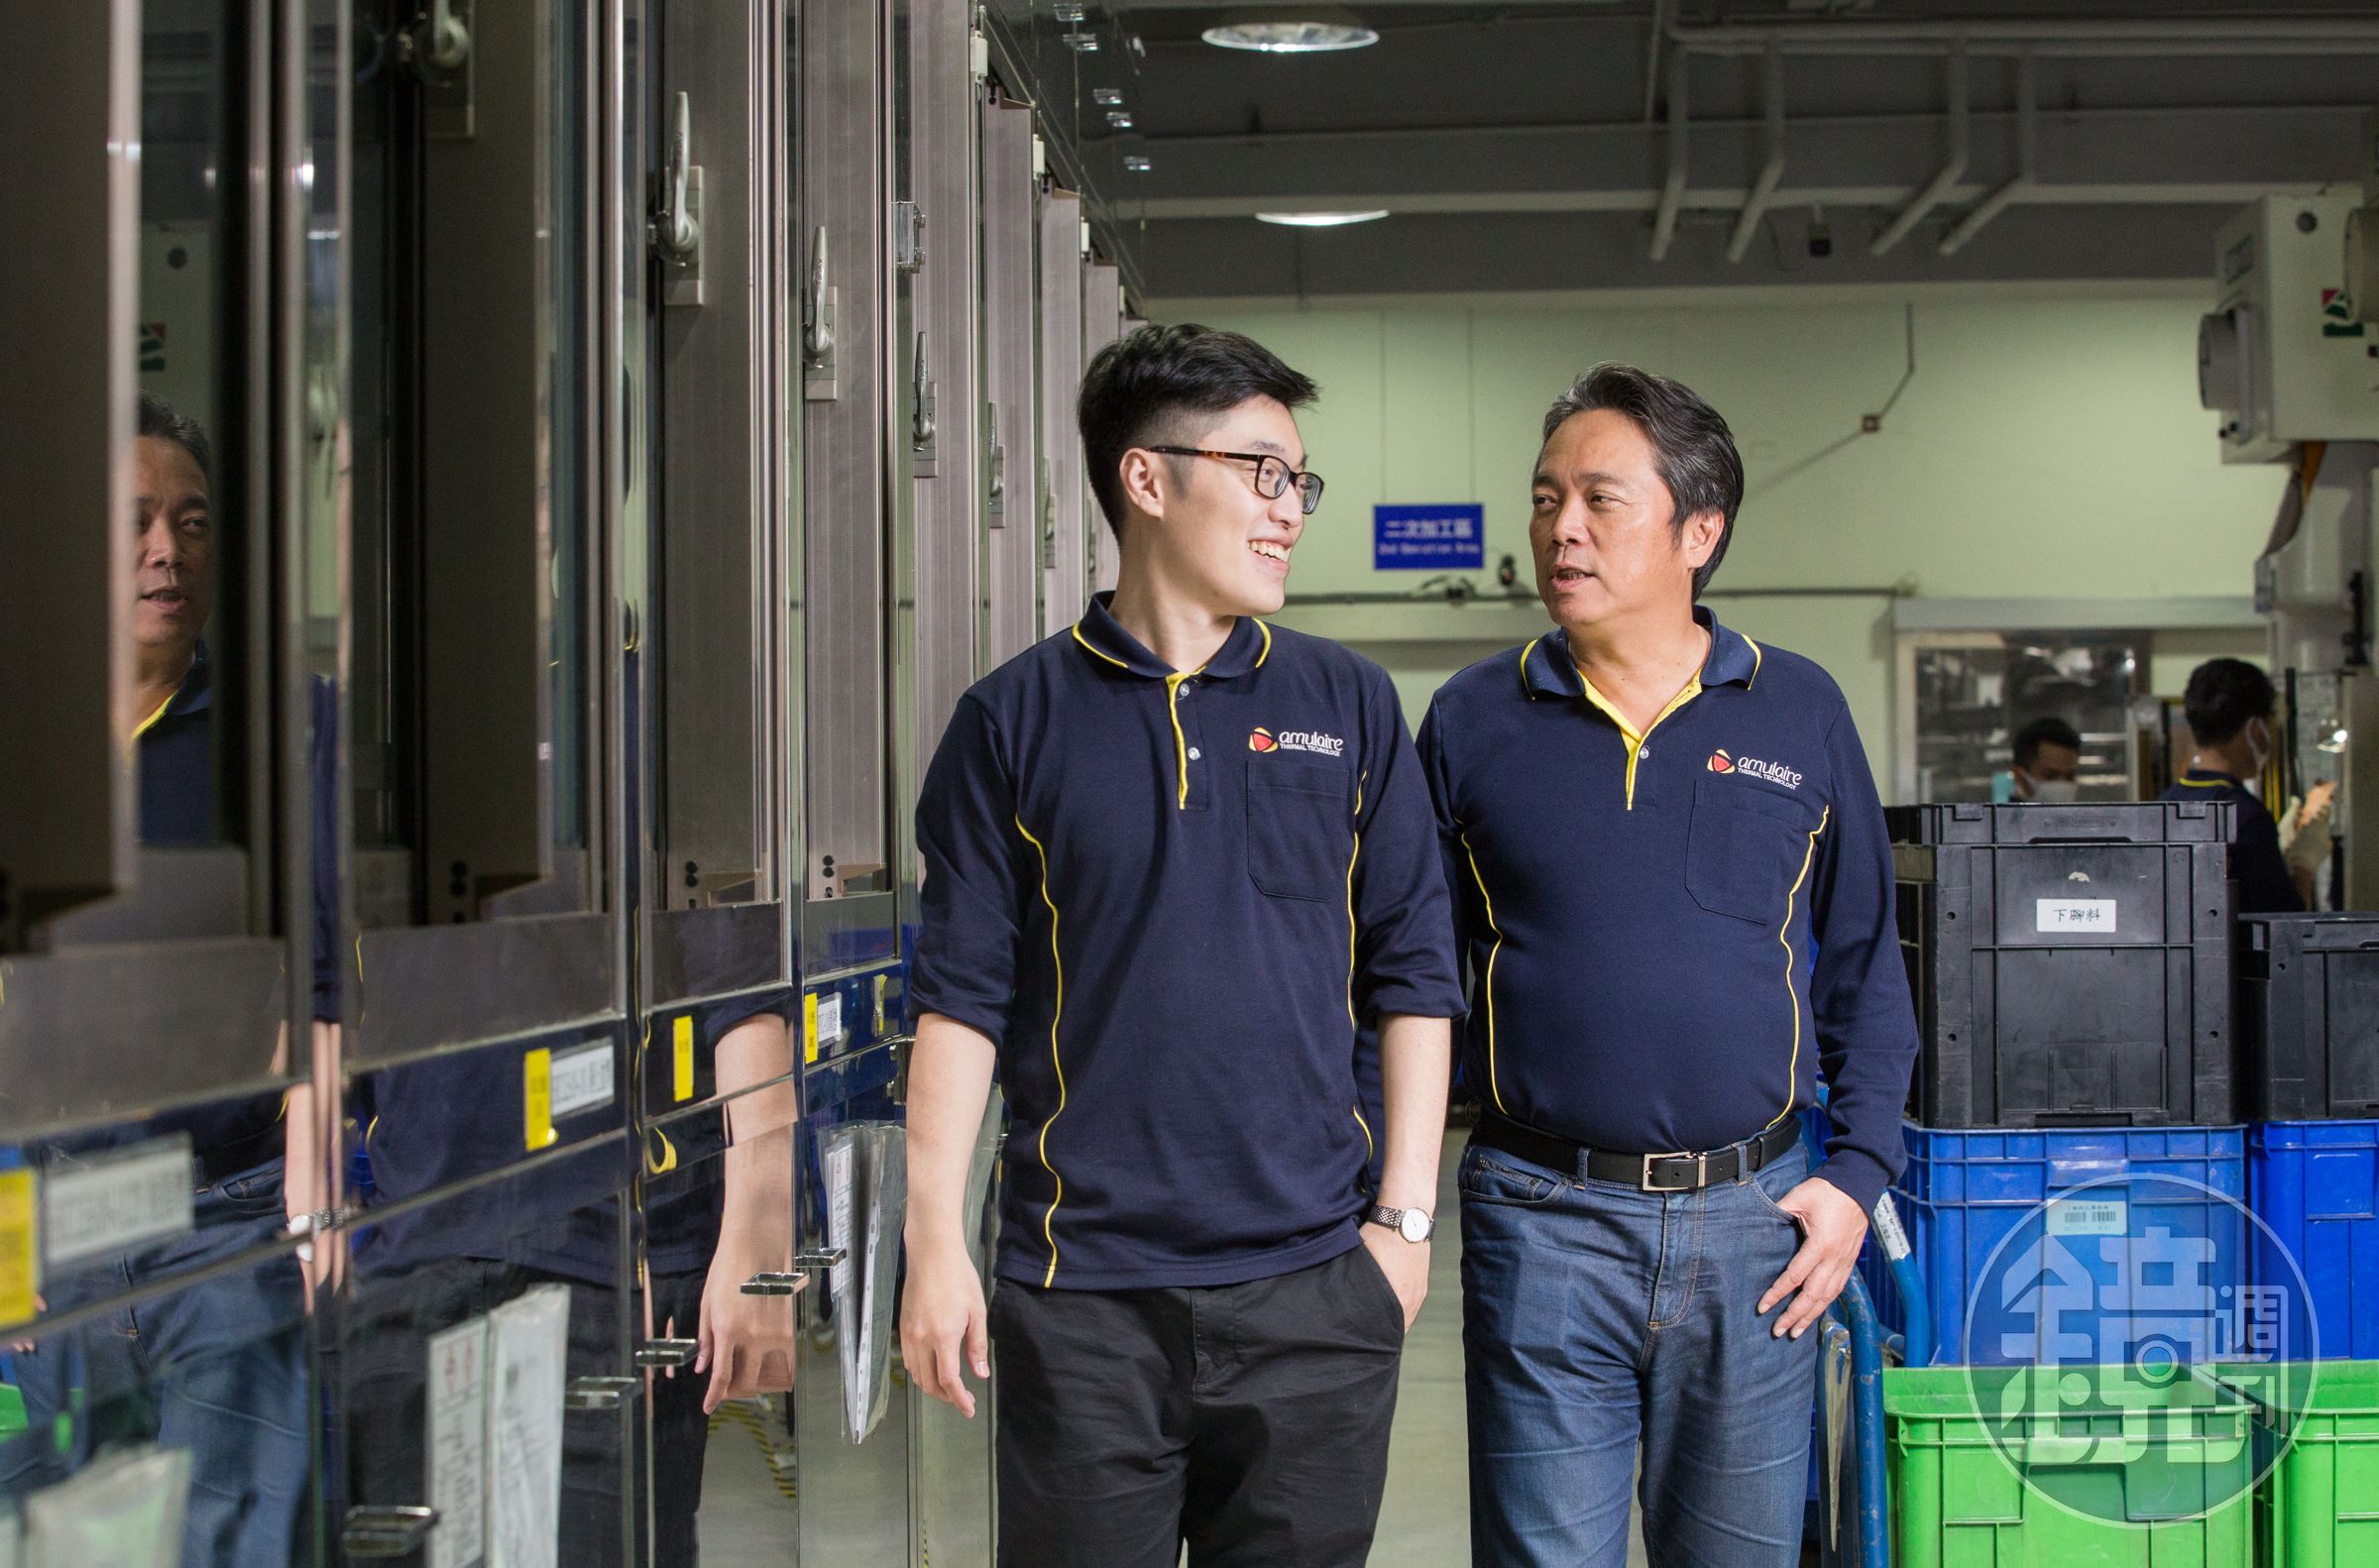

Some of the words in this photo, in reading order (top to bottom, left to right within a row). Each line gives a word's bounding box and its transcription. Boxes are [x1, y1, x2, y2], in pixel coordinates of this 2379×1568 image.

[1279, 731, 1343, 751] amulaire
[1280, 742, 1307, 751] THERMAL
[1738, 756, 1802, 785] amulaire
[1738, 767, 1762, 779] THERMAL
[1763, 773, 1796, 790] TECHNOLOGY
